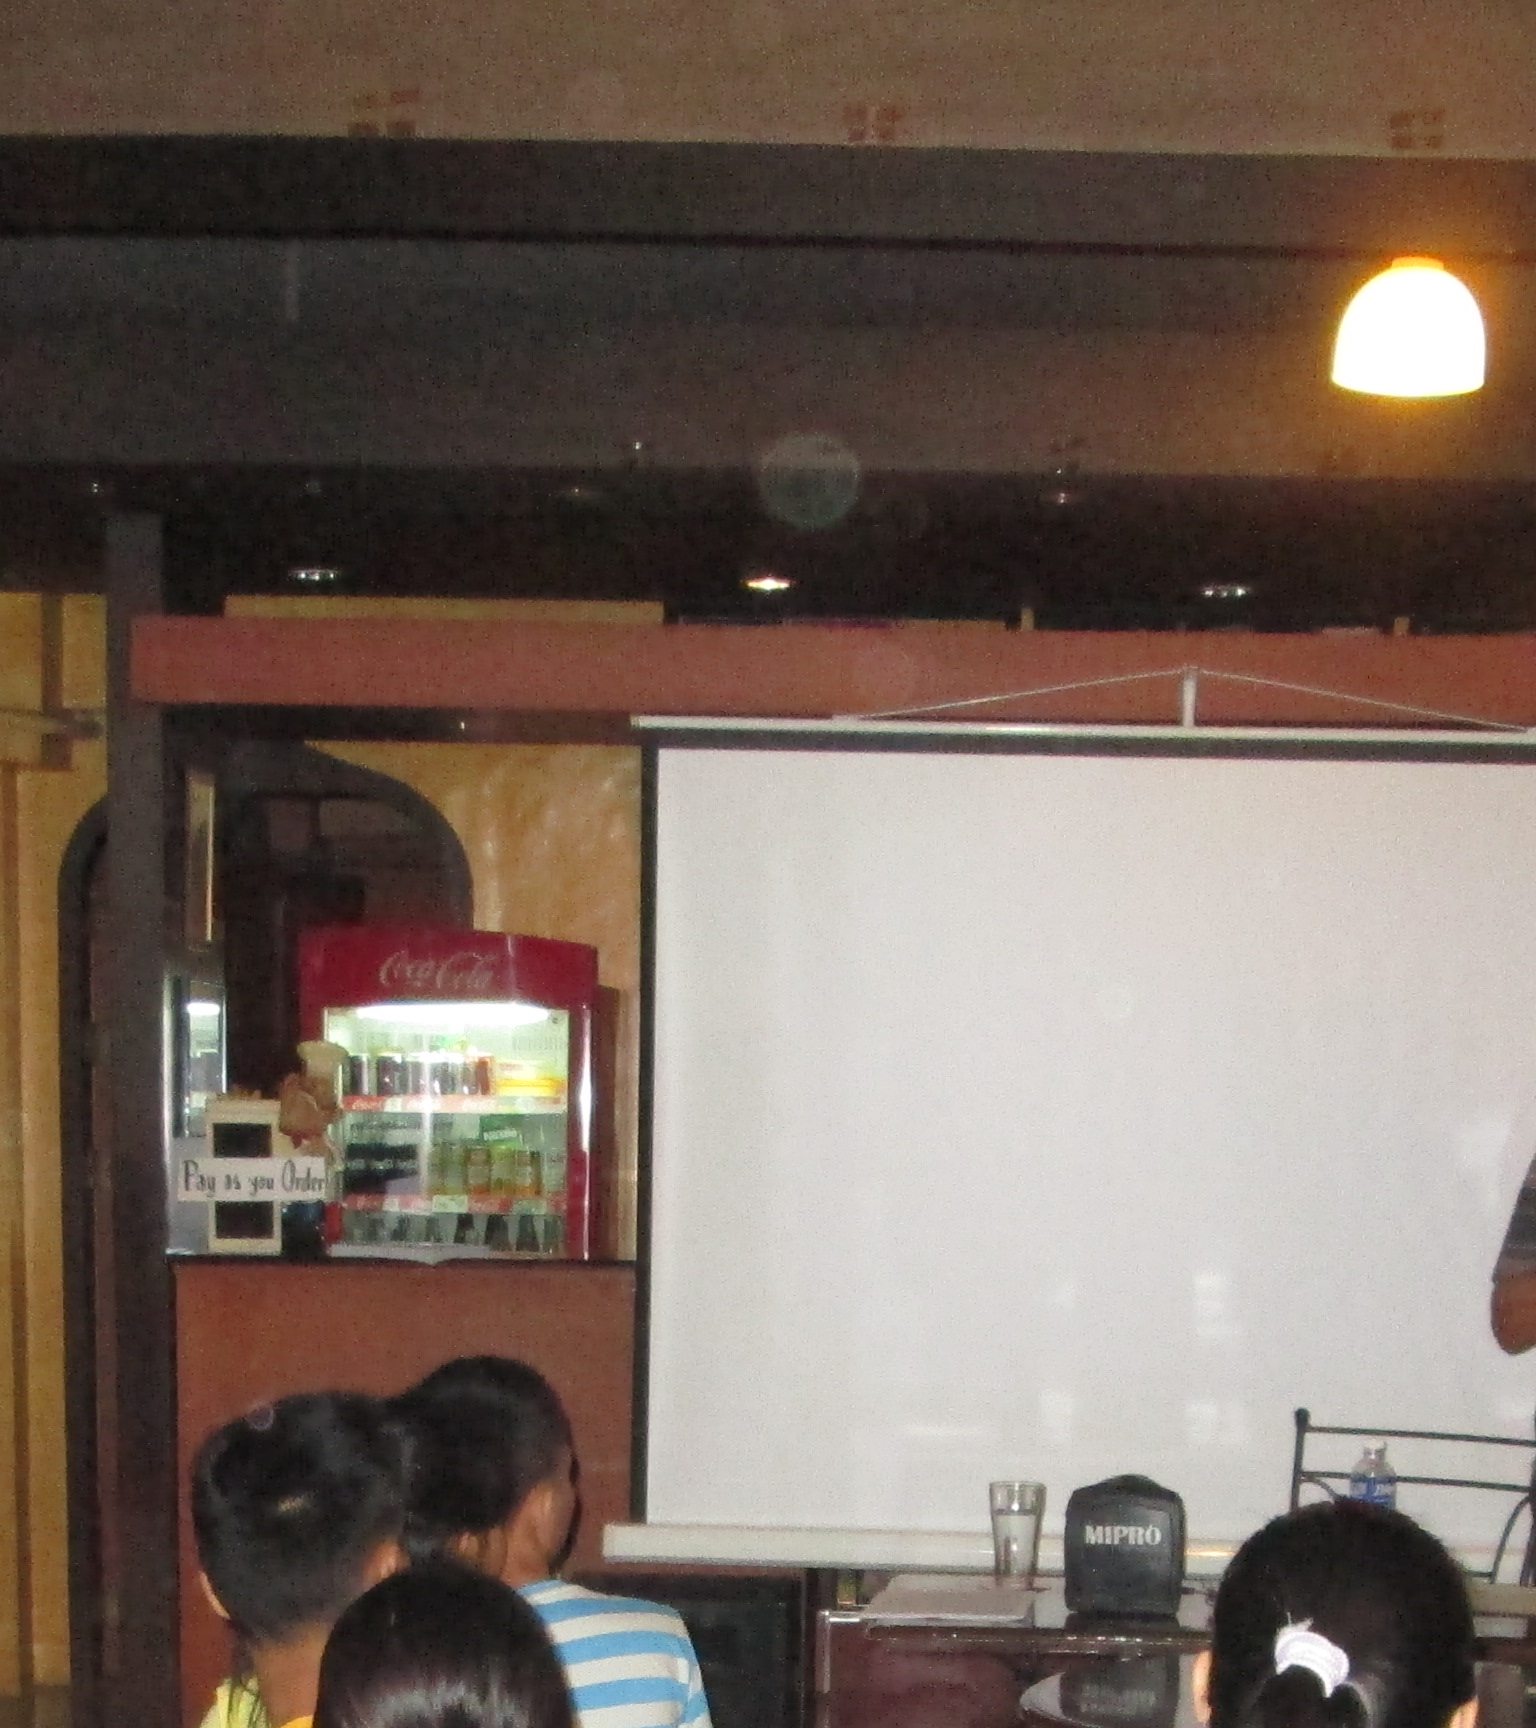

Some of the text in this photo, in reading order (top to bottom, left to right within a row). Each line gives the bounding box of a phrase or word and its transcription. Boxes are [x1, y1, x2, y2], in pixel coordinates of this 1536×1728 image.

[183, 1159, 326, 1197] Pay as you Order
[1085, 1524, 1162, 1546] MIPRO
